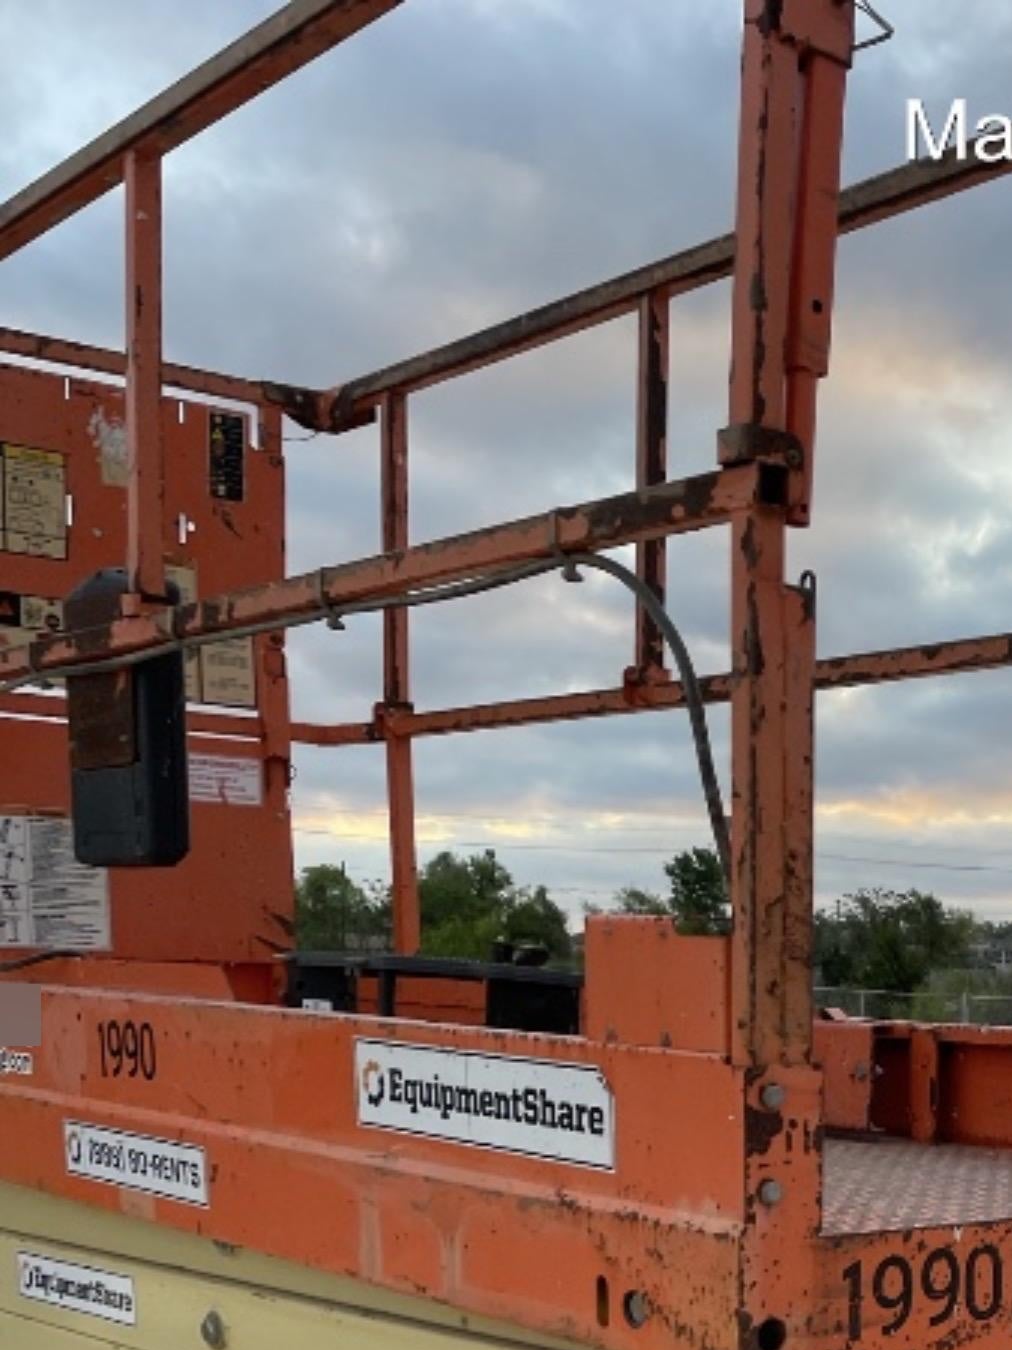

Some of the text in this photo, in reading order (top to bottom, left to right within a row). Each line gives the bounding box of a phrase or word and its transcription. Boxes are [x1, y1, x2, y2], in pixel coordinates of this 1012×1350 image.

[97, 1019, 156, 1080] 1990
[388, 1066, 605, 1136] EquipmentShare
[843, 1244, 1003, 1342] 1990
